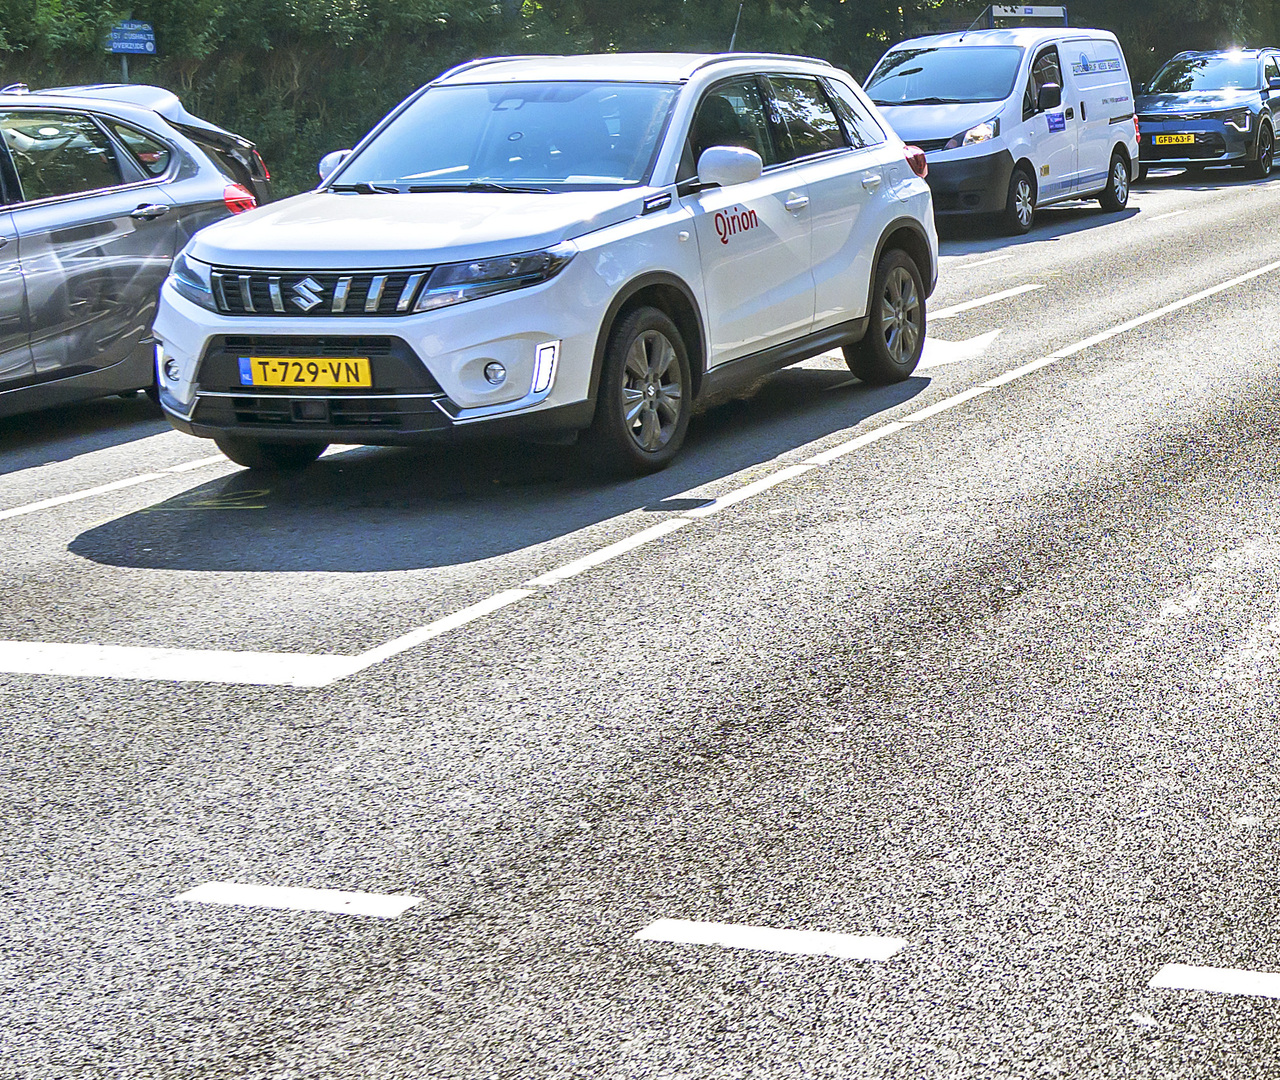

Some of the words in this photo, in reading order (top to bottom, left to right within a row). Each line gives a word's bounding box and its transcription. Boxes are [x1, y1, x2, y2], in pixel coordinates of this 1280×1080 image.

[1158, 135, 1192, 143] GFB-63-F
[714, 206, 759, 245] Qirion
[257, 361, 361, 383] T-729-VN
